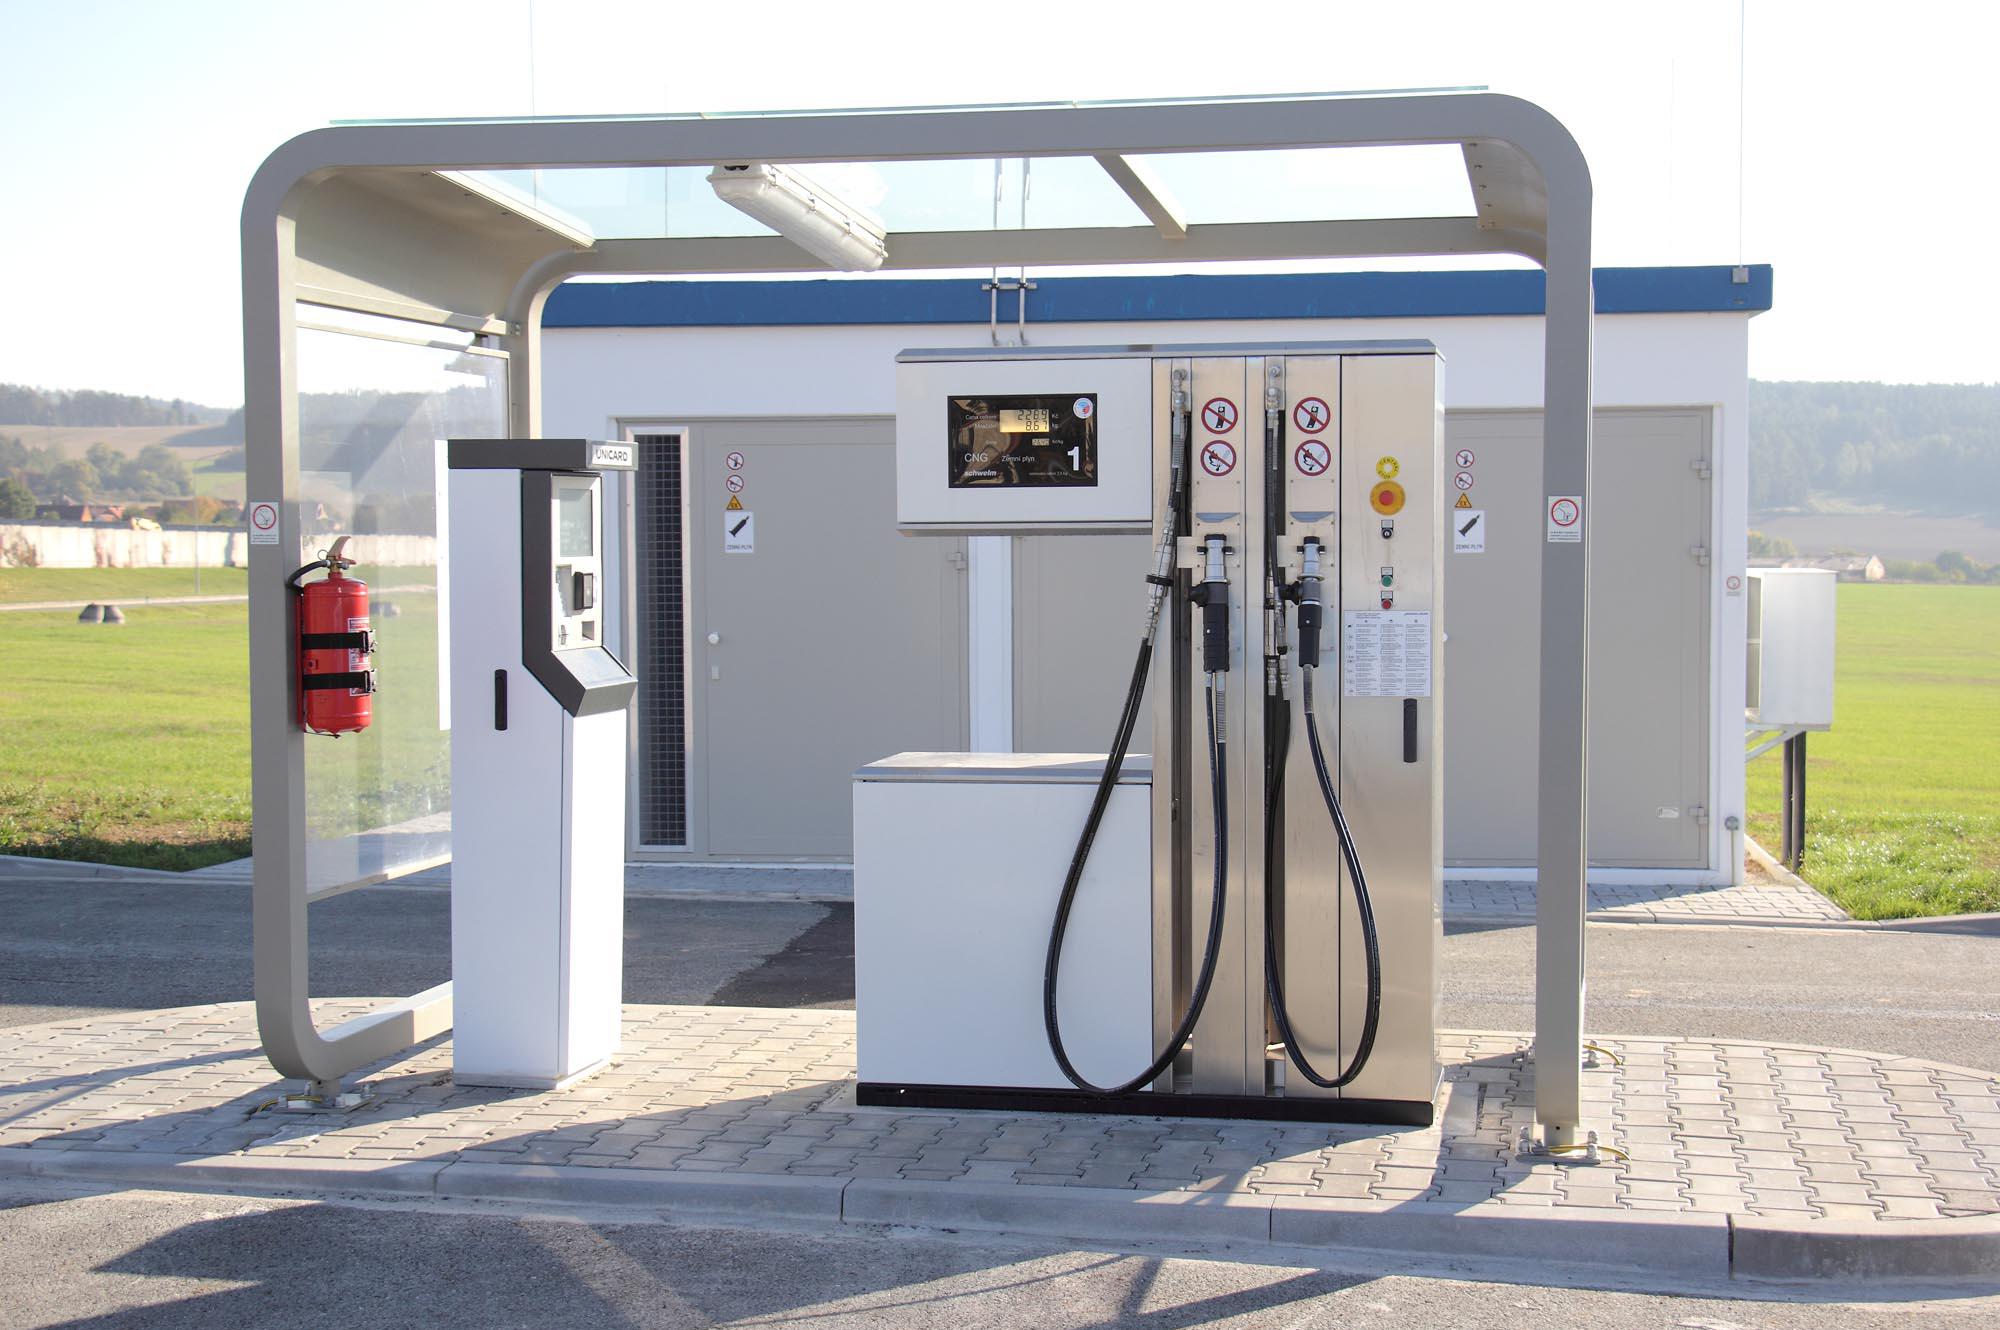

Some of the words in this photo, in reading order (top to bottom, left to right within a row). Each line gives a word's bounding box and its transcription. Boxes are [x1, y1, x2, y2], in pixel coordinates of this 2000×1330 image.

[595, 448, 628, 461] UNICARD
[964, 453, 988, 462] CNG
[1022, 455, 1035, 463] plyn
[1067, 446, 1080, 471] 1
